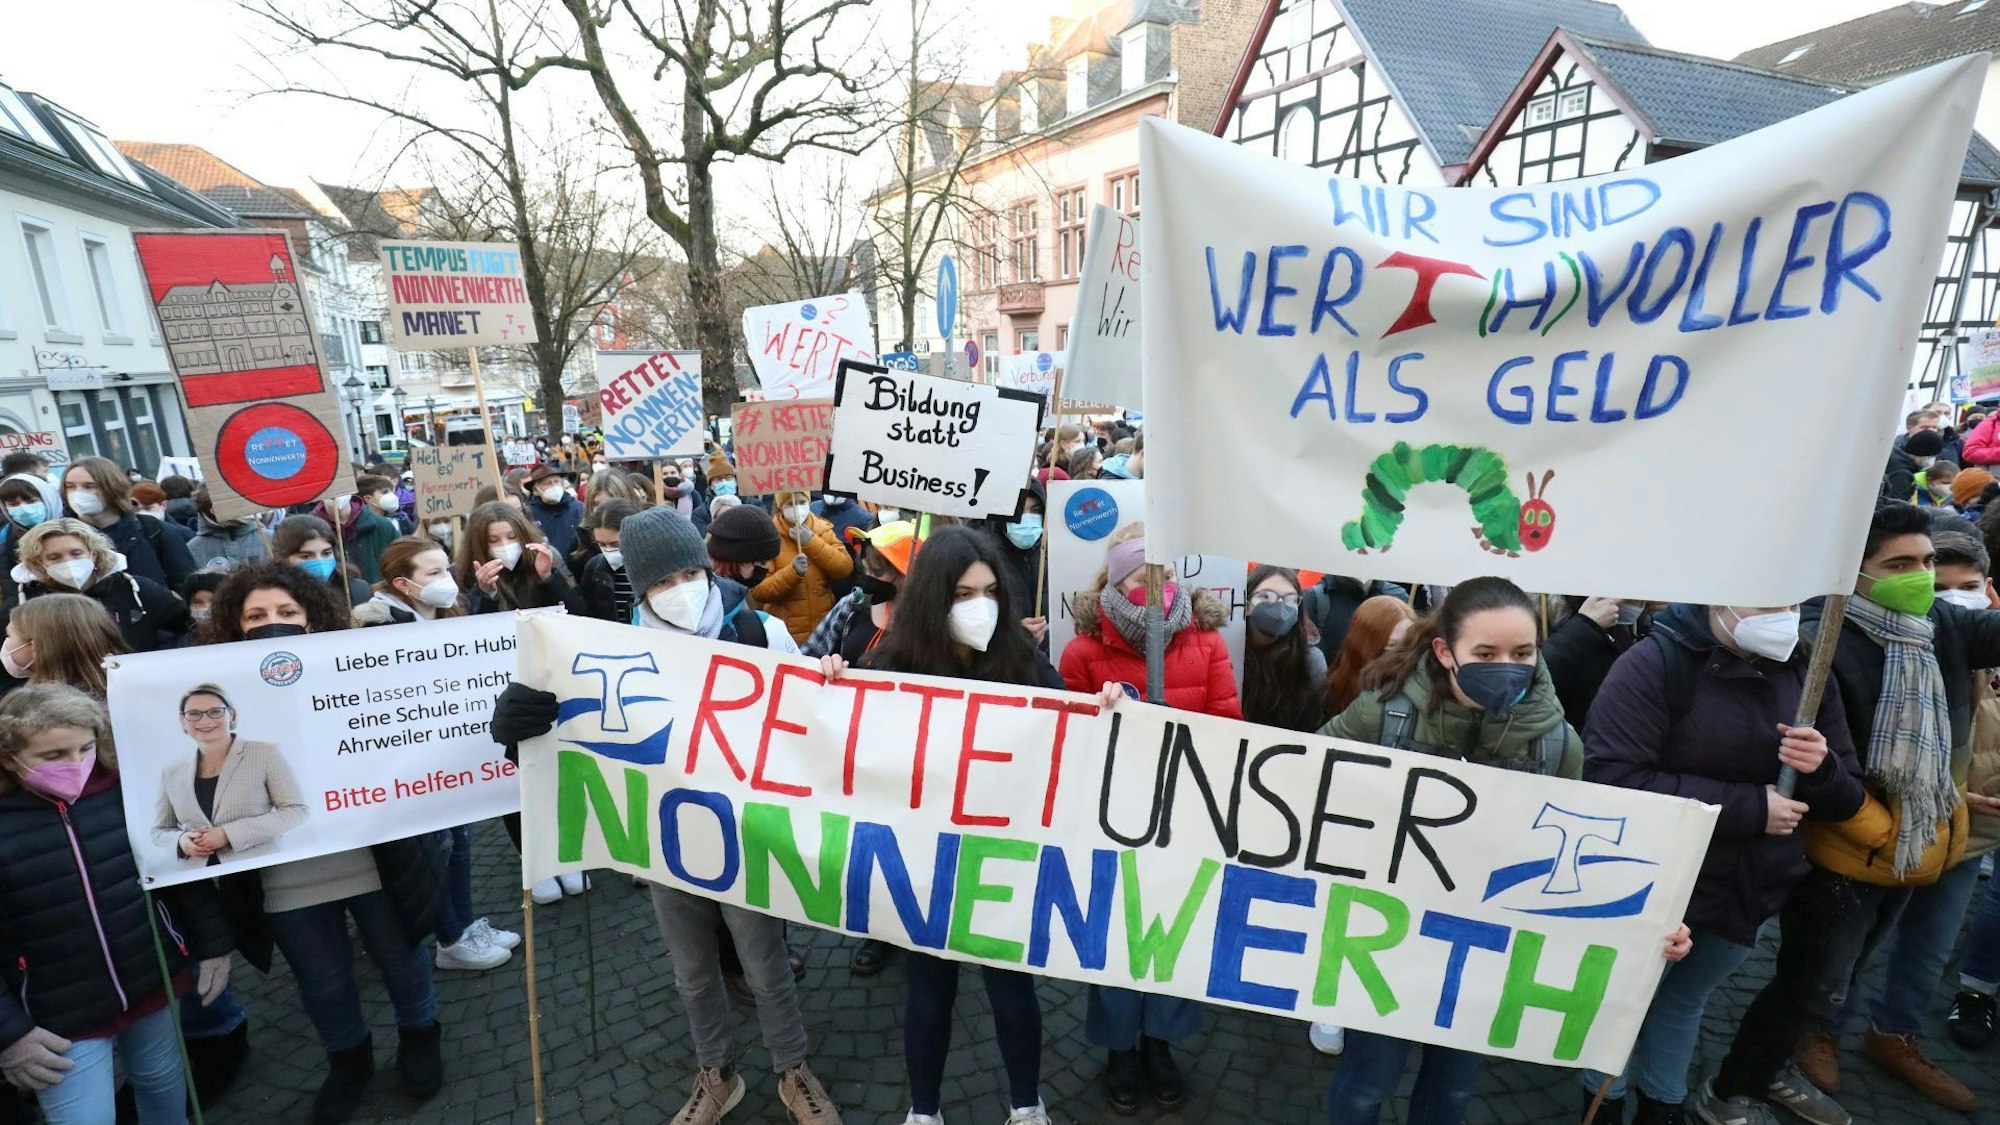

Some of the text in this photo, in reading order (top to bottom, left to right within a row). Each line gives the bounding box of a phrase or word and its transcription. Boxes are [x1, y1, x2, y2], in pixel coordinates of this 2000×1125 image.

[1328, 178, 1661, 247] WIR SIND
[382, 246, 518, 274] TEMPUS FUGIT
[1204, 191, 1892, 340] WERT(H)VOLLER
[392, 275, 526, 304] NONNENWERTH
[1098, 282, 1136, 338] Wir
[402, 310, 481, 336] MANET
[764, 320, 853, 381] WERT
[600, 351, 681, 416] RETTET
[864, 376, 981, 433] Bildung
[1290, 350, 1691, 424] ALS GELD
[604, 371, 699, 455] NONNEN-
[639, 396, 703, 456] WERTH
[771, 403, 835, 433] RETTE
[887, 416, 960, 447] statt
[0, 432, 53, 448] LDUNG
[416, 448, 442, 466] Weil
[859, 449, 990, 506] Business!
[1069, 507, 1119, 530] Nonnenwerth
[335, 652, 389, 672] Liebe
[395, 648, 437, 664] Frau
[444, 643, 468, 658] Dr.
[312, 671, 512, 711] bitte lassen Sie nicht
[348, 712, 391, 729] eine
[396, 700, 459, 722] Schule
[465, 698, 488, 713] im
[337, 728, 433, 756] Ahrweiler
[324, 760, 515, 811] Bitte helfen Sie
[684, 653, 1477, 892] RETTET UNSER
[557, 750, 1618, 1061] NONNENWERTH
